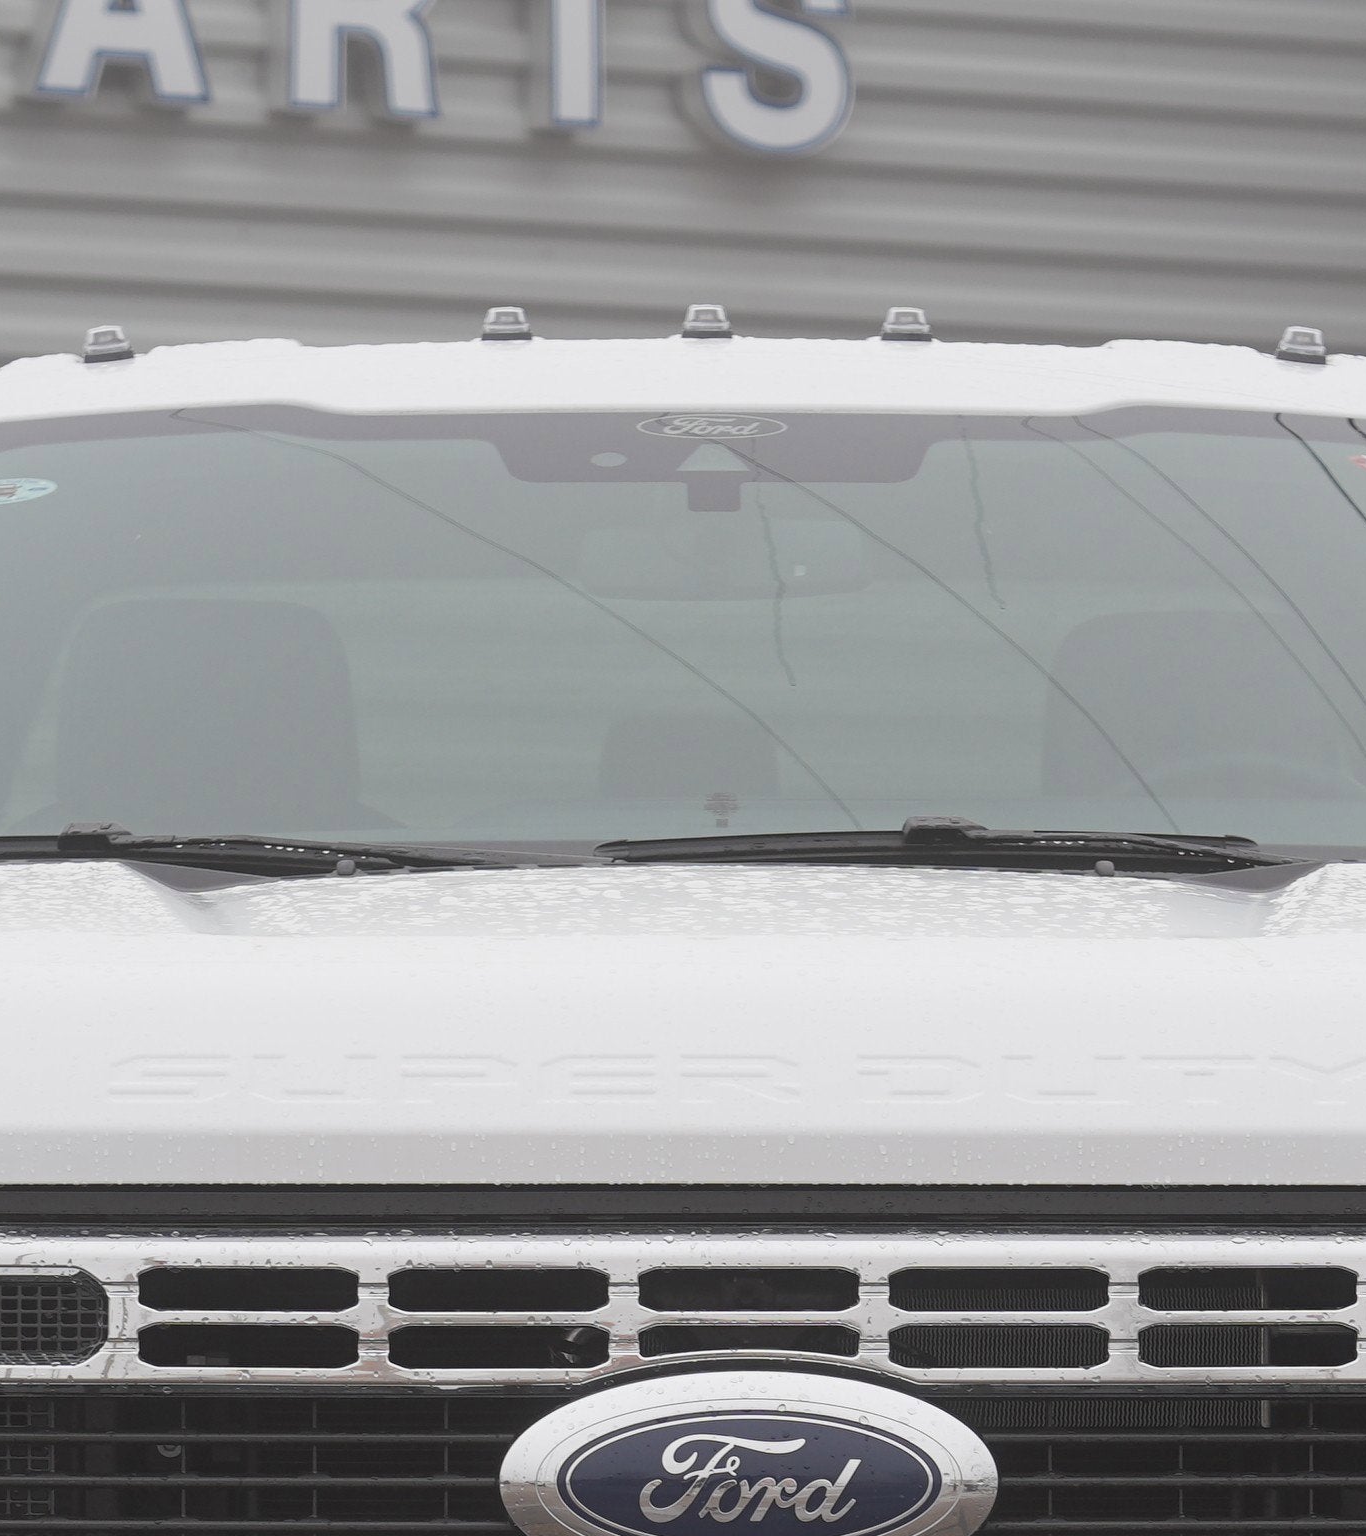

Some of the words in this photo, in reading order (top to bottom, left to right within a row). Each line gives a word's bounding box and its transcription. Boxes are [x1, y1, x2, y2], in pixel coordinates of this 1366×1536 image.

[663, 417, 759, 436] Ford
[105, 1052, 805, 1106] SUPER
[639, 1433, 860, 1523] Ford
